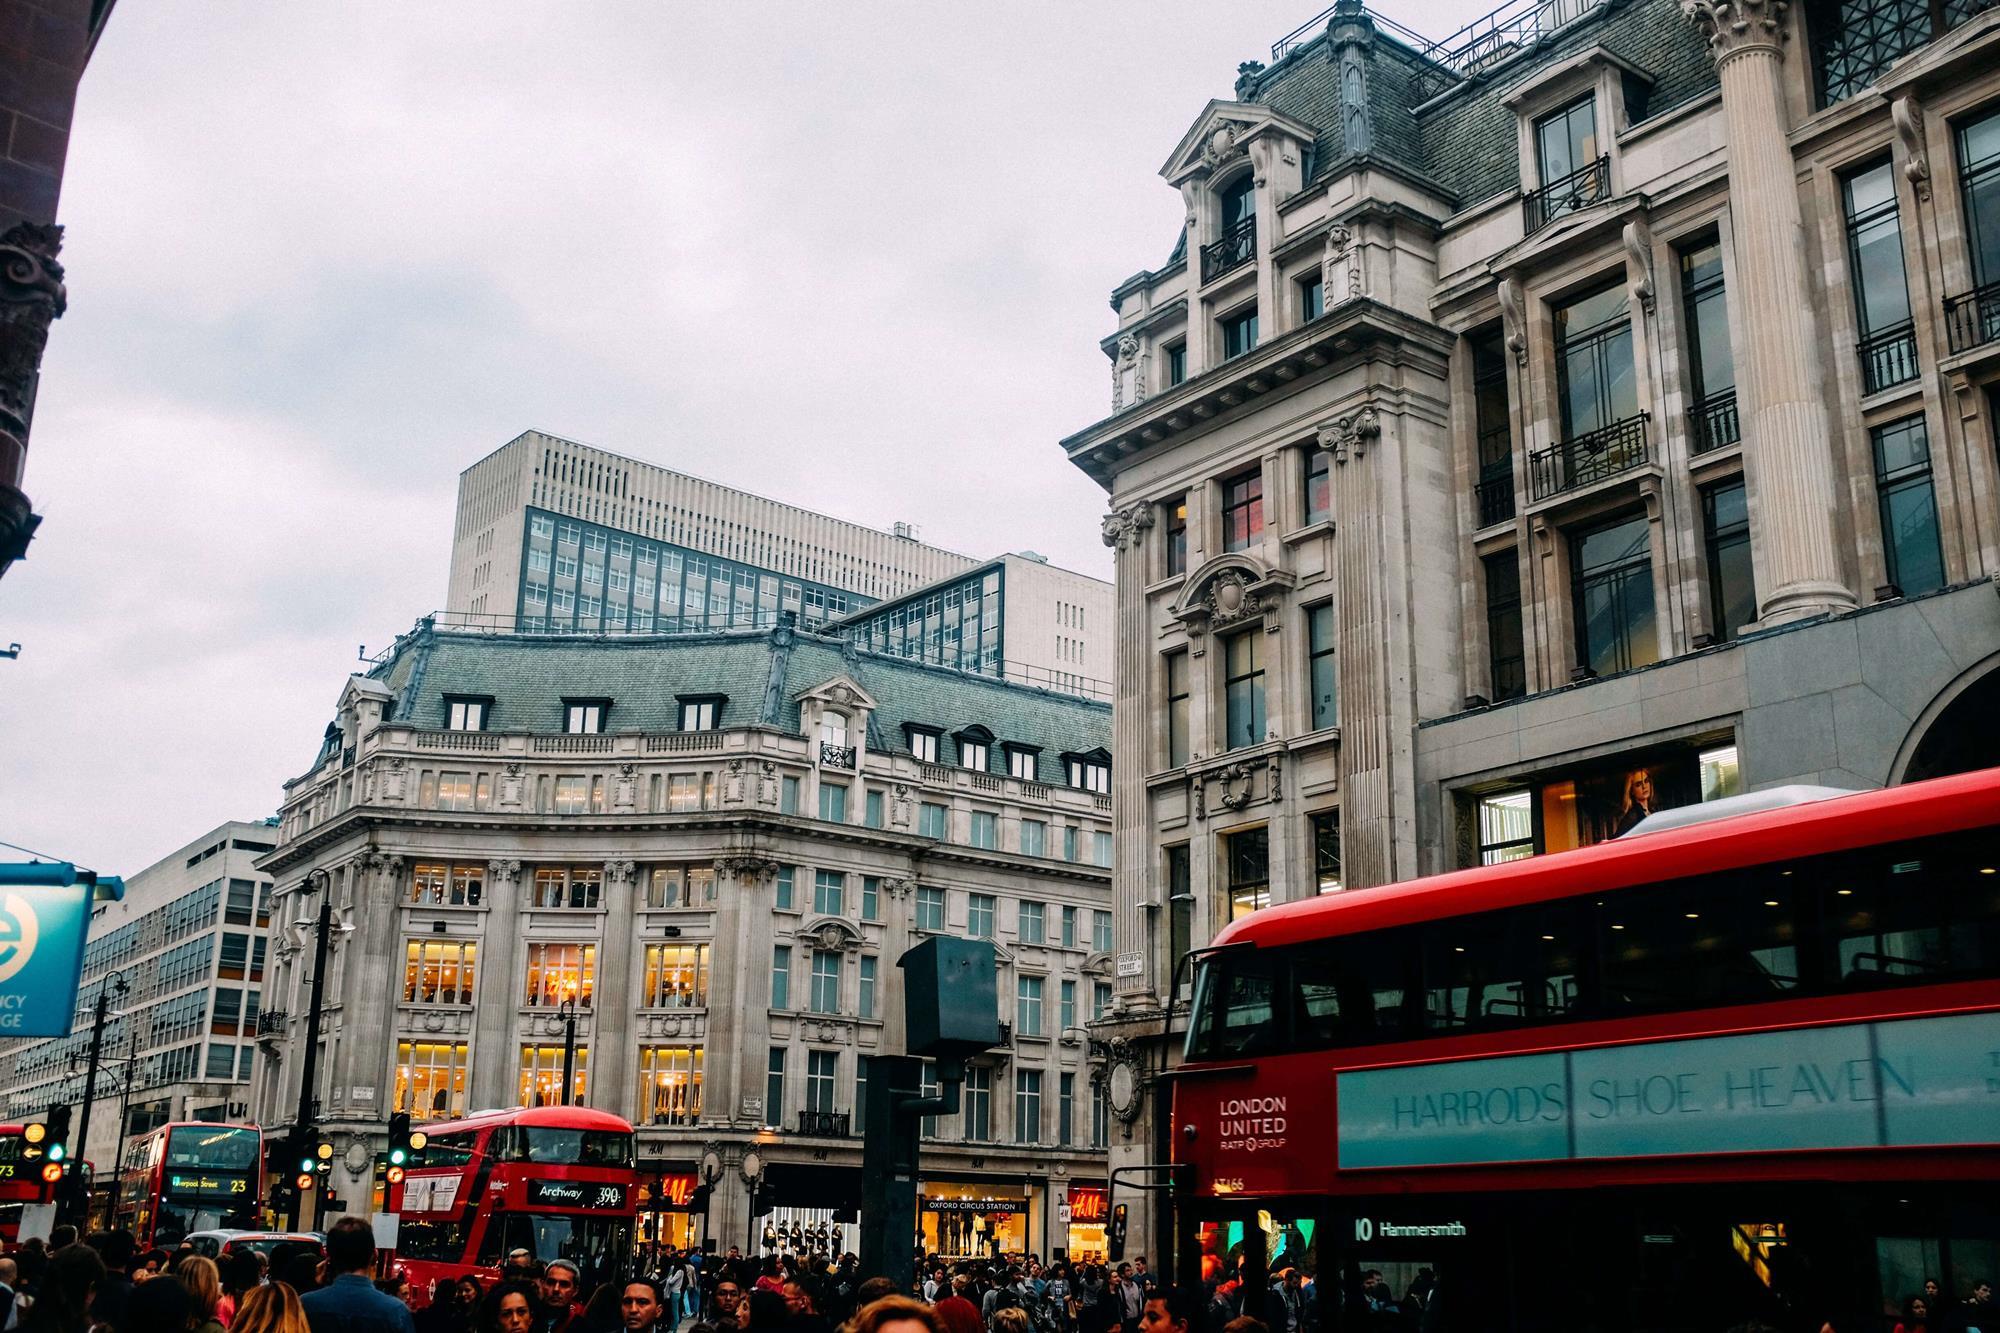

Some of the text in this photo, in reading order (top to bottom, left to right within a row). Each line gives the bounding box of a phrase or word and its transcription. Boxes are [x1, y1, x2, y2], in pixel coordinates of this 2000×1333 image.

[1119, 962, 1135, 970] STREET
[0, 1013, 23, 1028] GE
[1394, 1056, 1915, 1130] HARRODS SHOE HEAVEN
[1220, 1096, 1287, 1116] LONDON
[1220, 1117, 1287, 1137] UNITED
[1220, 1138, 1287, 1151] RATP GROUP
[0, 1165, 14, 1178] 73
[230, 1180, 246, 1193] 23
[540, 1185, 619, 1204] Archway 390
[929, 1201, 958, 1209] OXFORD
[959, 1202, 985, 1210] CIRCUS
[1072, 1193, 1101, 1219] H&M
[1355, 1217, 1467, 1241] 10 Hammersmith
